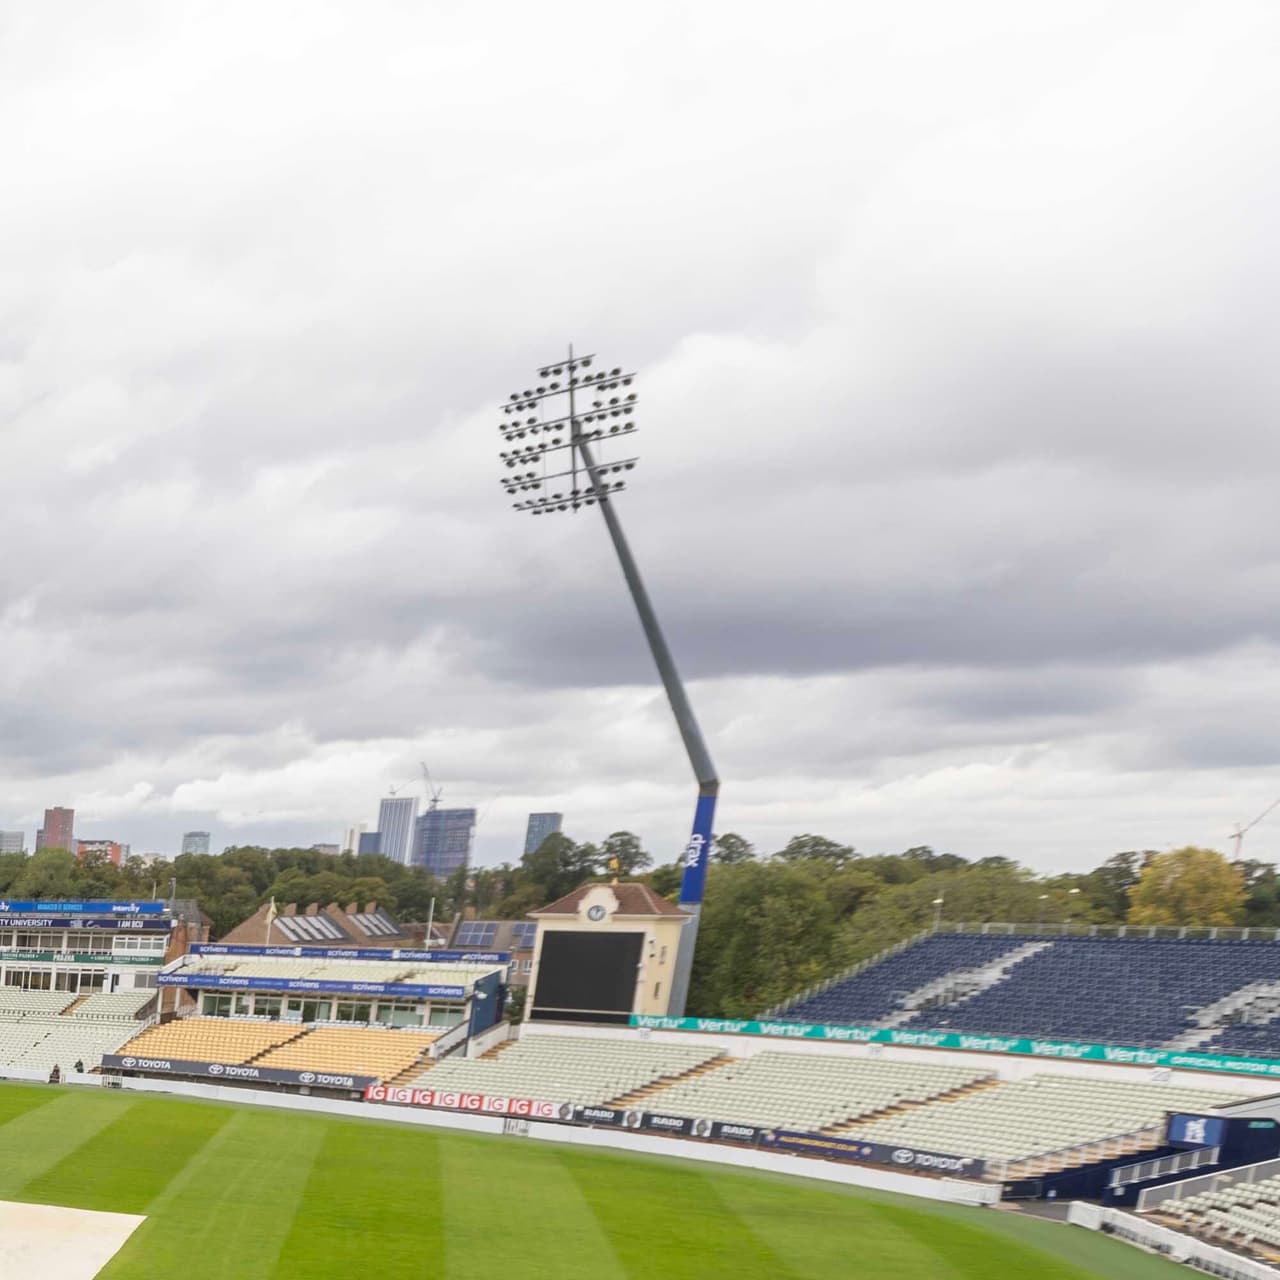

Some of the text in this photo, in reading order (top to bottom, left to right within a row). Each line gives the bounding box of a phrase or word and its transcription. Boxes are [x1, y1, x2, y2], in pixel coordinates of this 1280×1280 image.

[686, 833, 706, 868] drax
[10, 919, 53, 927] UNIVERSITY
[327, 949, 358, 957] scrivens
[158, 974, 188, 983] scrivens
[219, 977, 249, 985] scrivens
[289, 981, 320, 989] scrivens
[352, 984, 385, 992] scrivens
[428, 987, 462, 997] scrivens
[138, 1058, 171, 1069] TOYOTA
[1171, 1055, 1221, 1068] OFFICIAL
[1225, 1060, 1267, 1072] MOTOR
[225, 1065, 260, 1077] TOYOTA
[317, 1073, 354, 1086] TOYOTA
[368, 1086, 385, 1100] IG
[392, 1088, 408, 1102] IG
[415, 1090, 432, 1104] IG
[439, 1092, 456, 1107] IG
[463, 1094, 481, 1110] IG
[488, 1097, 505, 1112] IG
[511, 1099, 529, 1115] IG
[537, 1102, 553, 1117] IG
[584, 1108, 614, 1120] RADO
[652, 1115, 684, 1128] RADO
[721, 1124, 754, 1137] RADO
